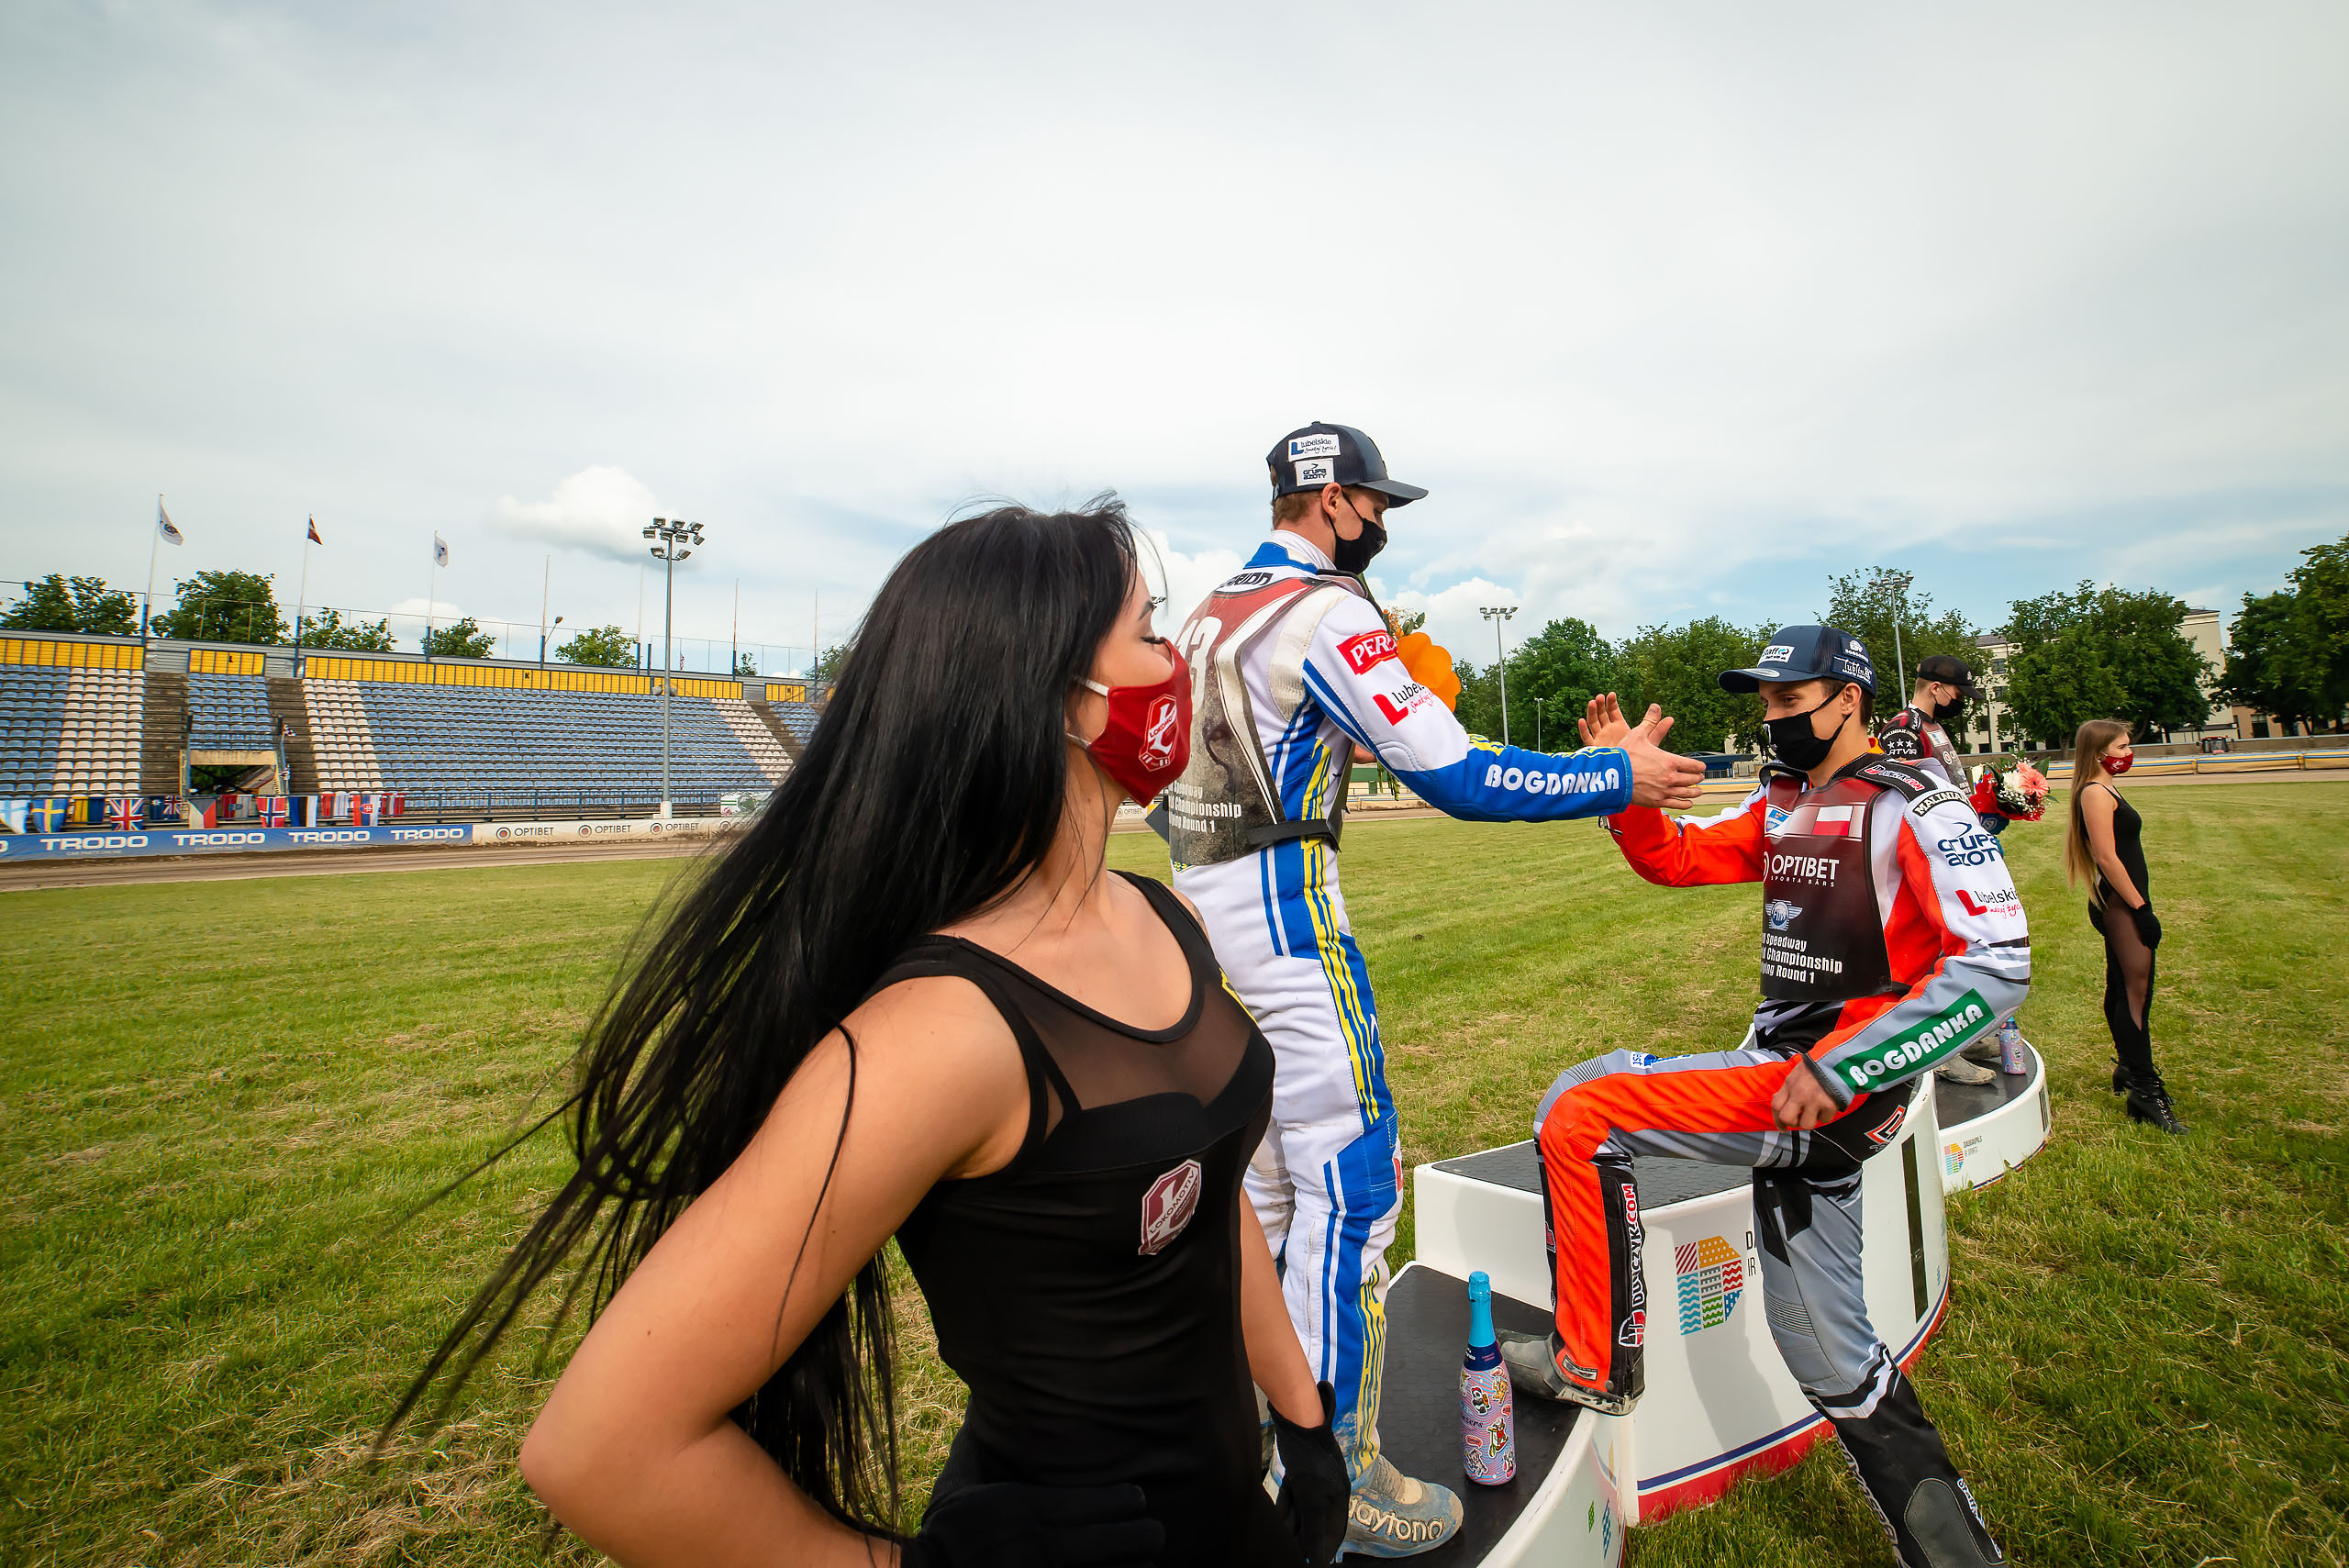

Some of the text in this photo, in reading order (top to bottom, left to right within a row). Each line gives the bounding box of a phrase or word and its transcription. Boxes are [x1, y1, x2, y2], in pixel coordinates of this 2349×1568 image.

[1485, 763, 1620, 795] BOGDANKA
[1175, 796, 1242, 818] Championship
[515, 827, 554, 837] OPTIBET
[595, 825, 631, 835] OPTIBET
[665, 822, 699, 832] OPTIBET
[1183, 817, 1207, 832] Round
[1209, 820, 1215, 833] 1
[39, 835, 149, 851] TRODO
[173, 832, 266, 846] TRODO
[288, 830, 371, 843] TRODO
[390, 828, 464, 841] TRODO
[1772, 854, 1840, 880] OPTIBET
[1766, 932, 1807, 952] Speedway
[1766, 947, 1842, 974] Championship
[1776, 964, 1806, 983] Round
[1809, 972, 1815, 984] 1
[1849, 1004, 1985, 1086] BOGDANKA
[1150, 1170, 1195, 1234] LOKOMOTIV
